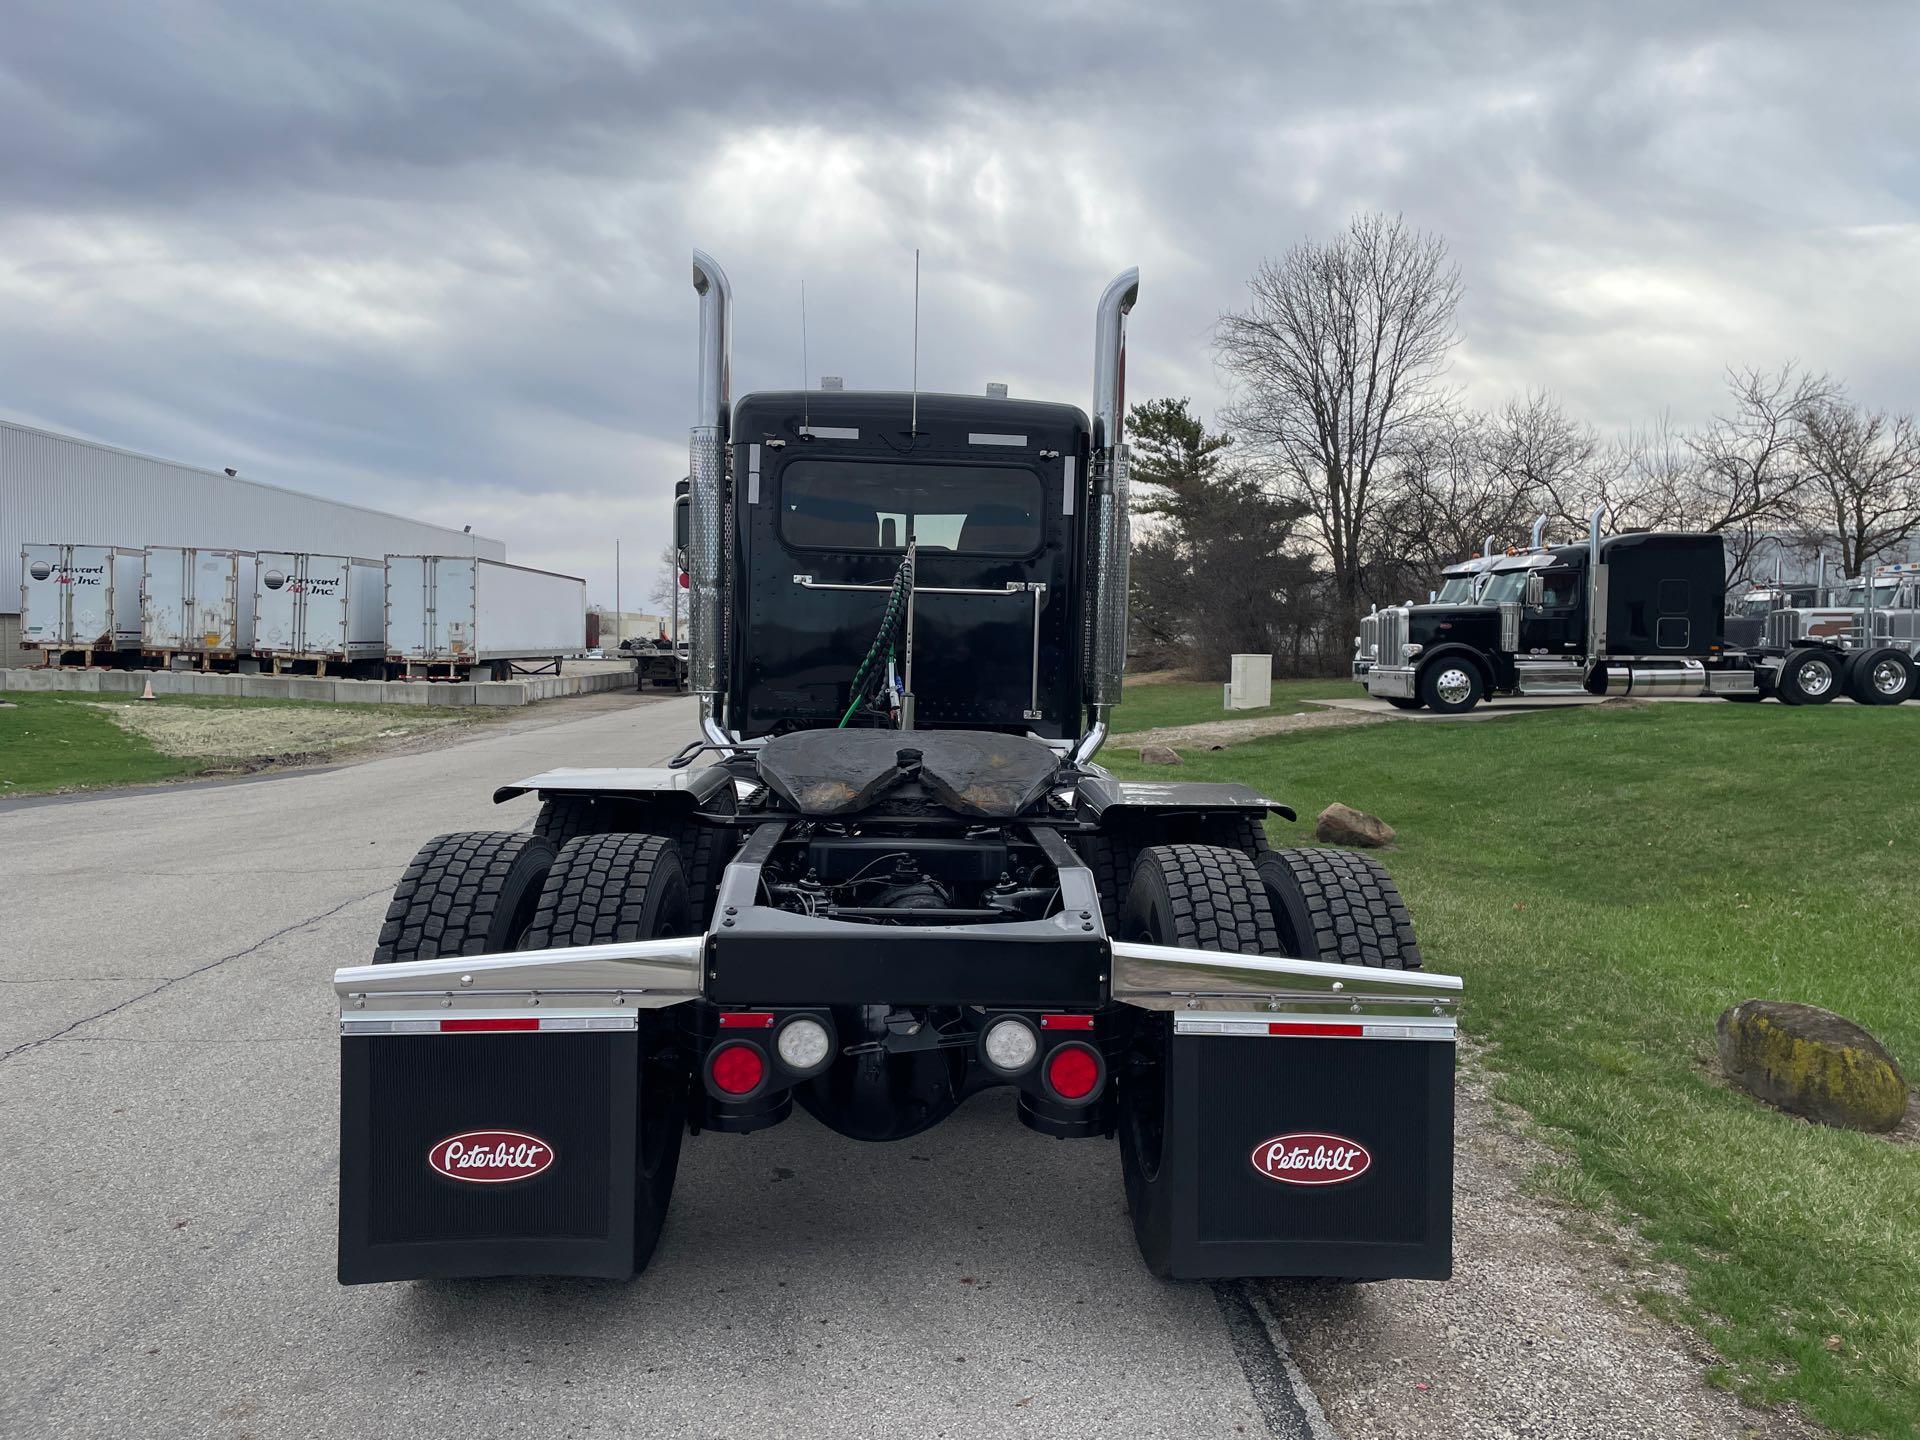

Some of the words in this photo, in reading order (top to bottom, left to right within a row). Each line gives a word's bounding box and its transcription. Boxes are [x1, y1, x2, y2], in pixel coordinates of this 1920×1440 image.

[51, 564, 104, 574] Forward
[285, 575, 340, 586] Forward
[445, 1141, 544, 1170] Peterbilt
[1266, 1142, 1361, 1171] Peterbilt
